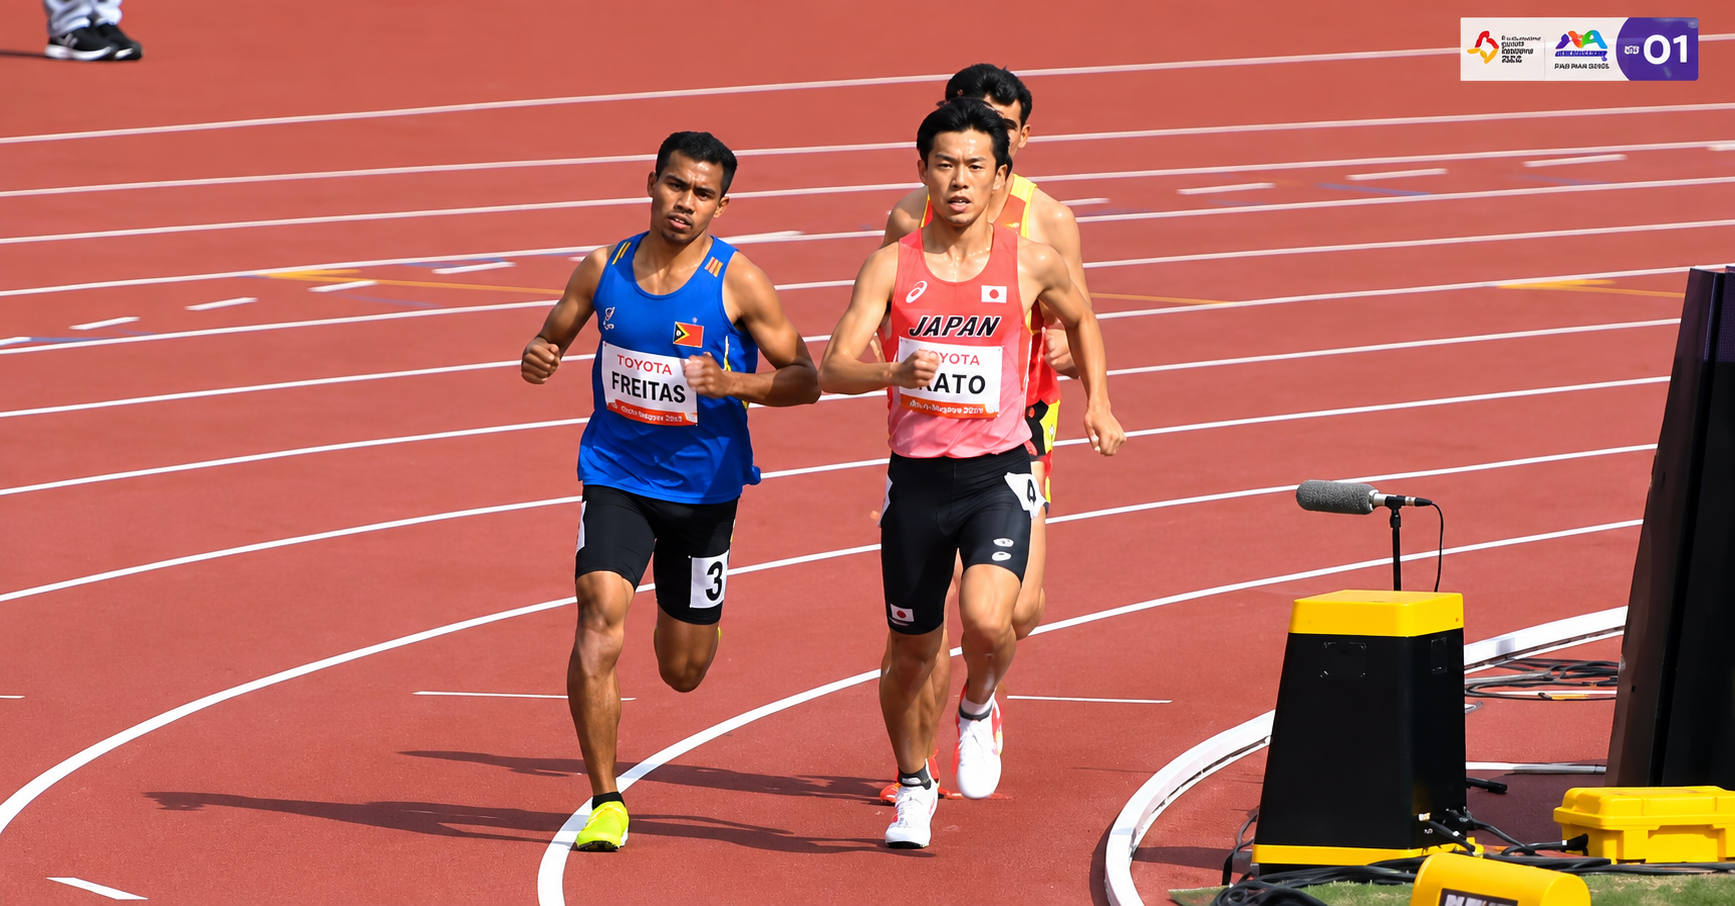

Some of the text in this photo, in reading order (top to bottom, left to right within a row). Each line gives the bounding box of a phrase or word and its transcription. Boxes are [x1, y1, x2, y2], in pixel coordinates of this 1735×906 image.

[909, 315, 1001, 338] JAPAN
[617, 354, 672, 376] TOYOTA
[611, 371, 686, 403] FREITAS
[919, 372, 986, 394] ATO
[705, 561, 723, 601] 3
